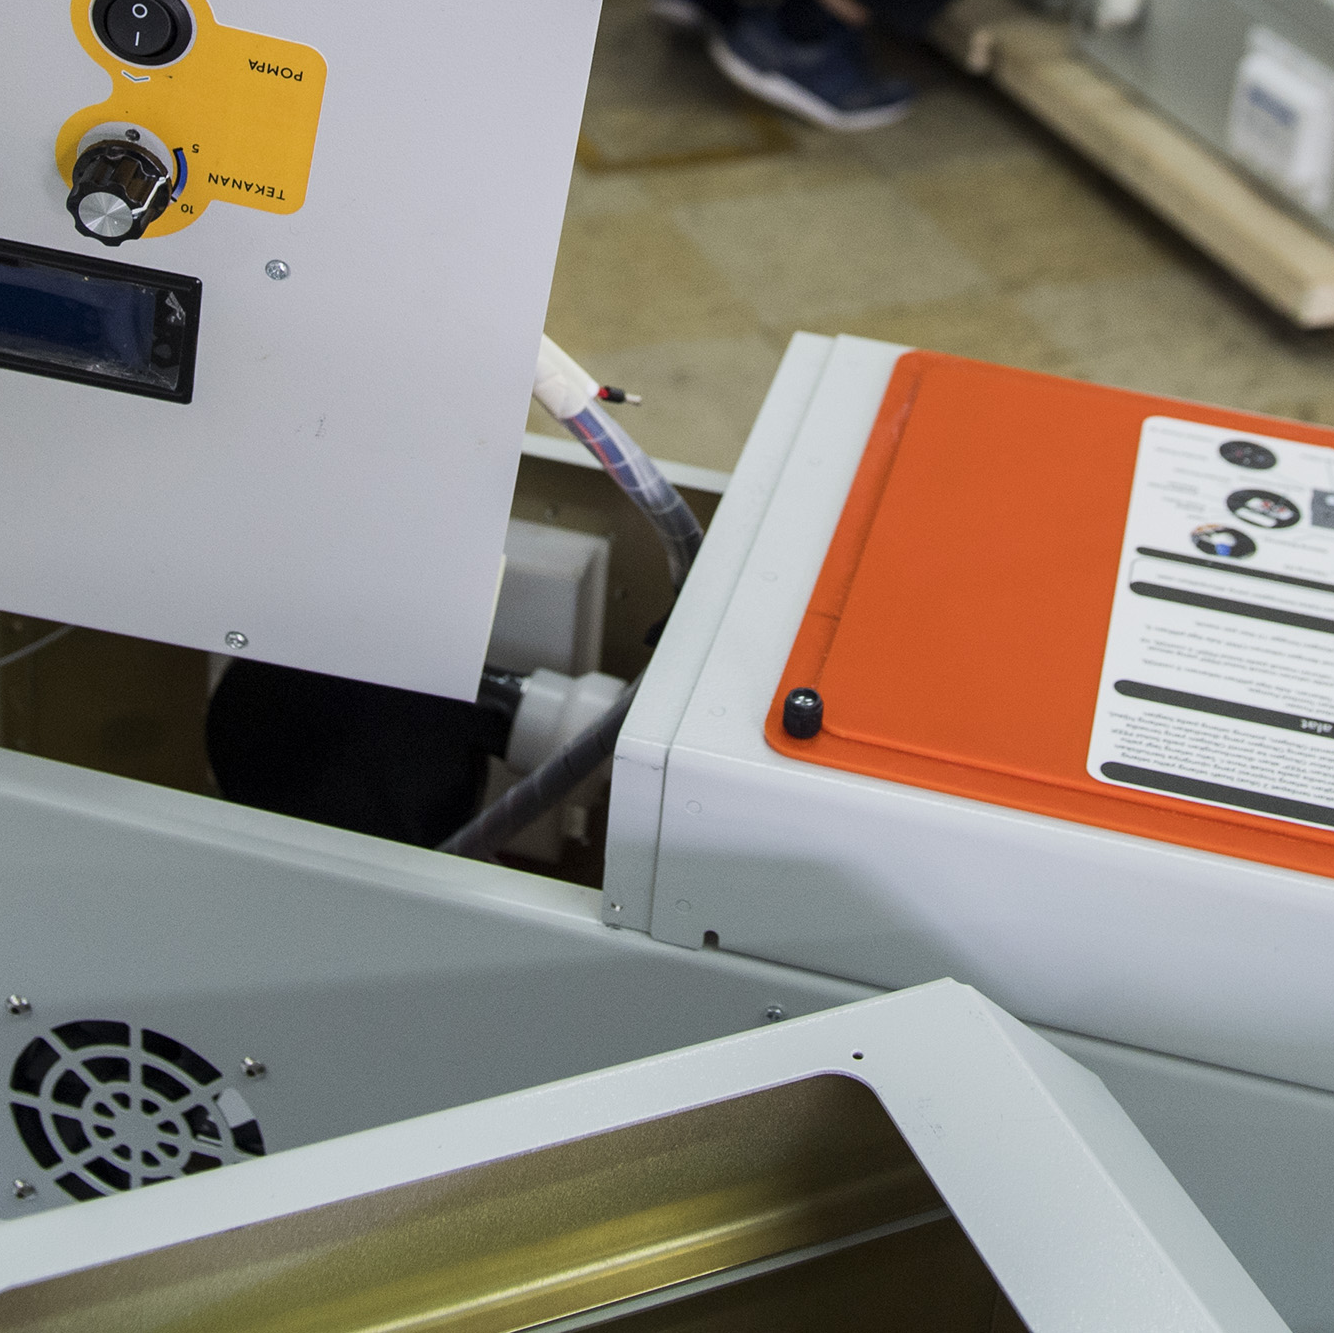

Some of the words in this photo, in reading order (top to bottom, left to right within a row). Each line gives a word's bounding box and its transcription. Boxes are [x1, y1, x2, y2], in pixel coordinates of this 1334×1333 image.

[247, 58, 304, 83] POMPA
[190, 144, 201, 154] 5
[206, 171, 286, 201] TEKANAN
[180, 203, 195, 215] 10
[1299, 718, 1334, 735] alat
